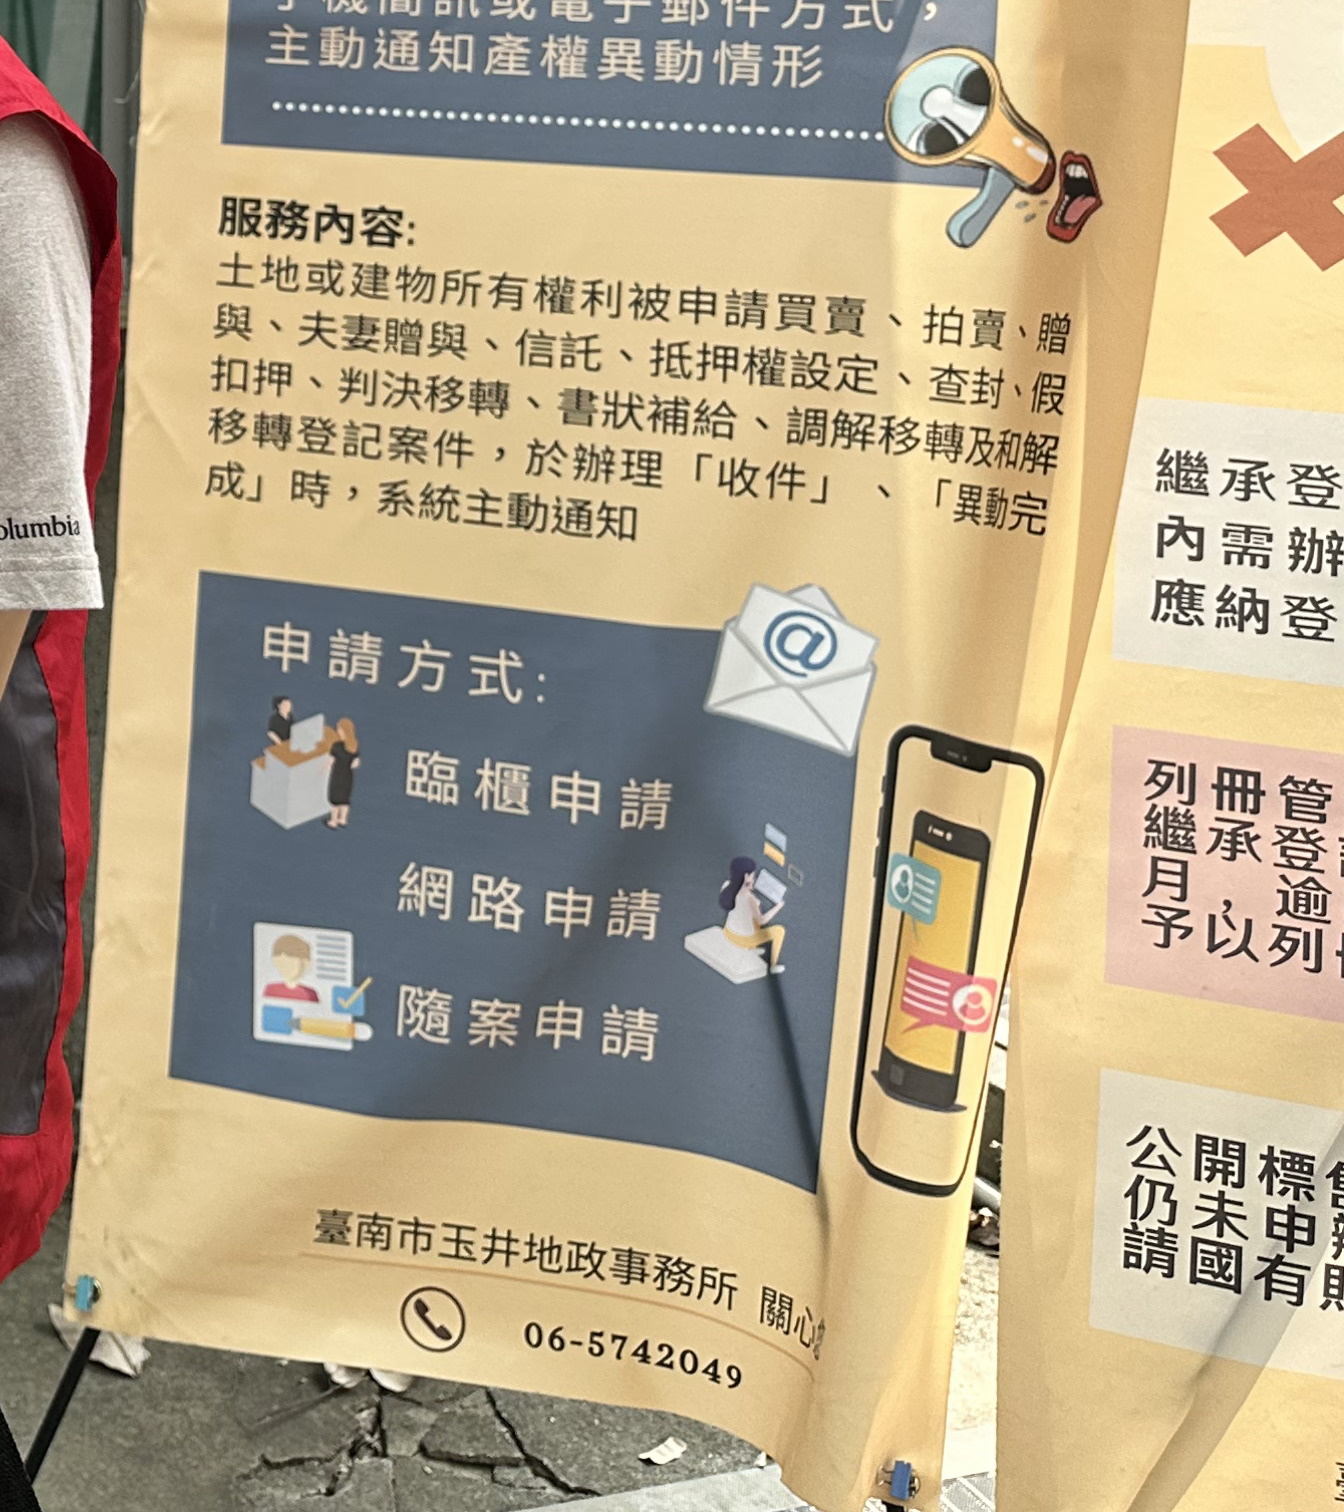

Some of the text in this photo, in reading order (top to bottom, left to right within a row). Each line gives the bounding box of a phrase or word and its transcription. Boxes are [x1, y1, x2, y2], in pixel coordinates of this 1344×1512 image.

[264, 24, 824, 88] 主動通知產權異動情形
[1155, 448, 1343, 510] 繼承登
[1155, 514, 1344, 578] 內需辦
[1150, 578, 1338, 643] 應納登
[261, 622, 549, 706] 申請方式:
[404, 748, 674, 833] 臨櫃申請
[1143, 759, 1334, 825] 列冊管
[1142, 803, 1344, 879] 繼承登
[397, 861, 662, 944] 網路申請
[1140, 903, 1344, 981] 予以列
[395, 986, 660, 1065] 隨案申請
[314, 1209, 826, 1361] 臺南市玉井地政事務所 關心
[523, 1321, 743, 1389] 06-5742049
